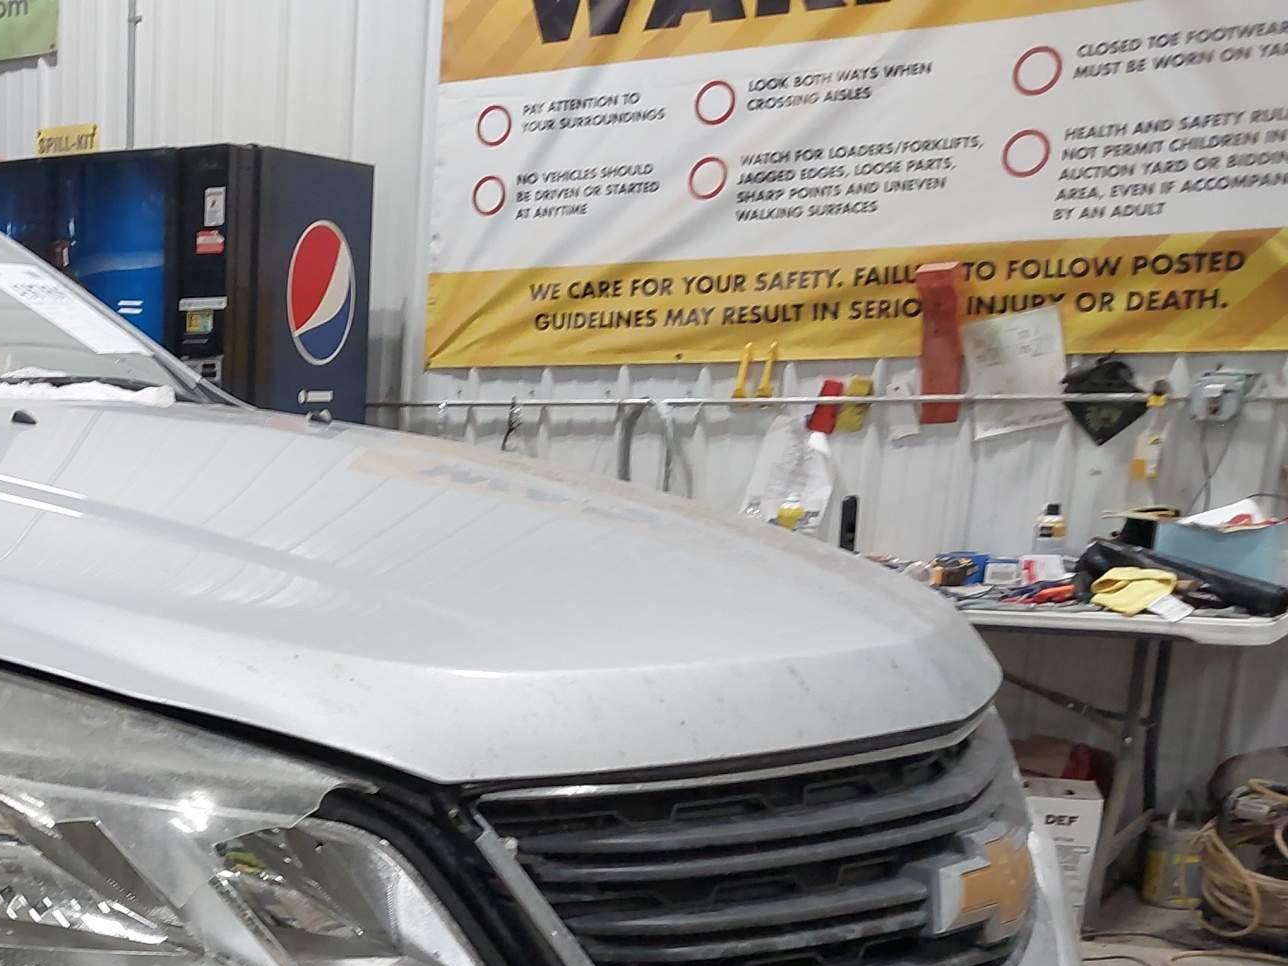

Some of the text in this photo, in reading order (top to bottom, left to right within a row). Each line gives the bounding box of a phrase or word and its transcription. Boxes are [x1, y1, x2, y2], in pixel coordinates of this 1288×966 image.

[1076, 38, 1142, 58] CLOSED
[1147, 32, 1180, 49] TOE
[1073, 61, 1121, 79] MUST
[1125, 58, 1146, 73] BE
[1152, 50, 1214, 70] WORN
[1220, 46, 1251, 62] ON
[748, 62, 933, 92] LOOK BOTH WAYS WHEN
[522, 92, 640, 116] PAY ATTENTION TO
[747, 87, 873, 111] CROSSING AISLES
[522, 107, 665, 133] YOUR SURROUNDINGS
[1064, 123, 1128, 141] HEALTH
[1132, 119, 1173, 135] AND
[1178, 111, 1245, 130] SAFETY
[740, 135, 984, 167] WATCH FOR LOADERS/FORKLIFTS,
[1061, 128, 1287, 161] NOT PERMIT CHILDREN IN
[517, 163, 654, 186] NO VEHICLES SHOULD
[737, 157, 956, 185] JAGGED EDGES, LOOSE PARTS,
[1058, 164, 1135, 181] AUCTION
[1142, 159, 1188, 174] YARD
[1193, 156, 1220, 171] OR
[516, 181, 660, 202] BE DRIVEN OR STARTED
[736, 176, 947, 203] SHARP POINTS AND UNEVEN
[1055, 186, 1104, 202] AREA,
[1110, 182, 1154, 198] EVEN
[1160, 180, 1175, 195] IF
[515, 203, 588, 220] AT ANYTIME
[736, 200, 878, 222] WALKING SURFACES
[1052, 202, 1166, 221] BY AN ADULT
[530, 250, 1245, 301] WE CARE FOR YOUR SAFETY. FAILU TO FOLLOW POSTED
[534, 308, 656, 332] GUIDELINES
[664, 306, 716, 327] MAY
[722, 302, 802, 325] RESULT
[813, 300, 840, 321] IN
[848, 297, 922, 320] SERIO
[1076, 290, 1114, 312] OR
[1127, 287, 1230, 312] DEATH.
[1044, 814, 1079, 826] DEF
